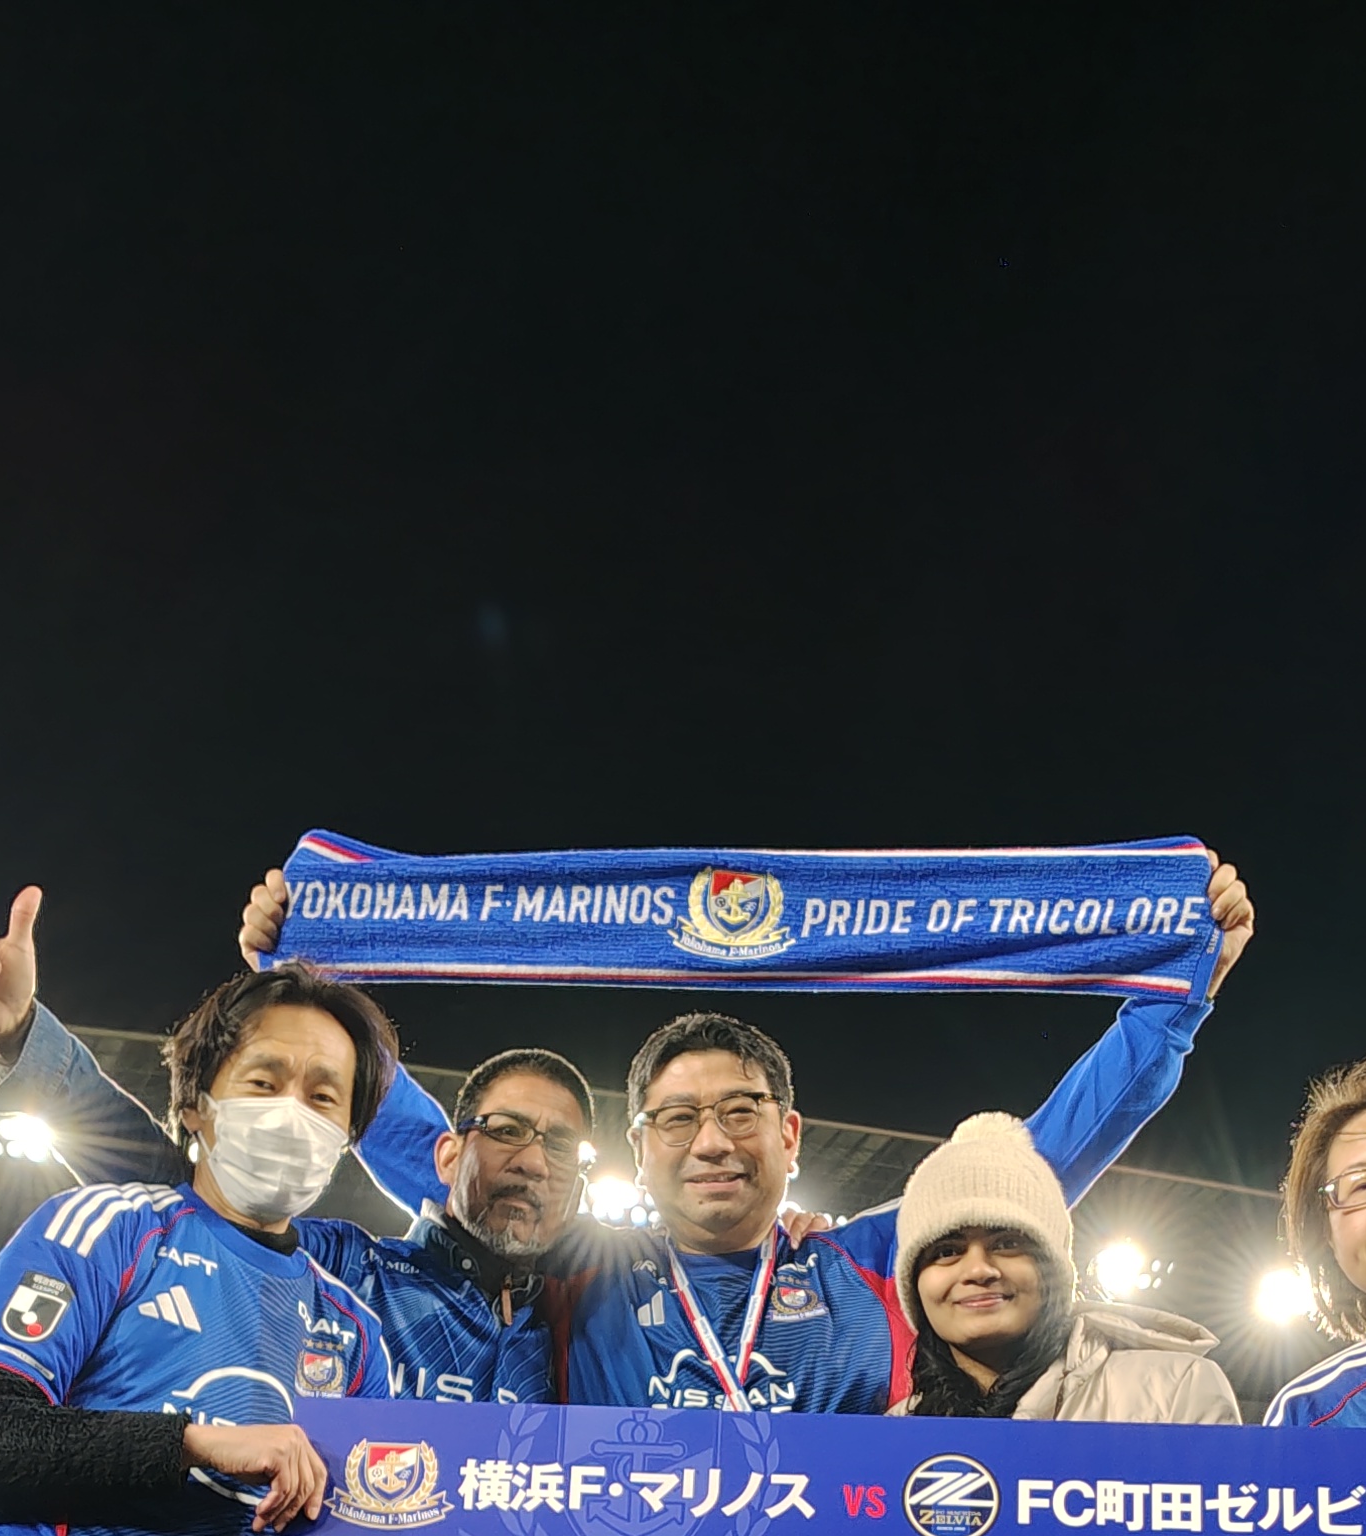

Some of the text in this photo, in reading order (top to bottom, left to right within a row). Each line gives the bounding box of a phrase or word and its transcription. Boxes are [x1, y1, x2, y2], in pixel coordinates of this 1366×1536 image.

[285, 881, 469, 921] YOKOHAMA
[800, 898, 915, 938] PRIDE
[926, 899, 978, 935] OF
[987, 896, 1206, 937] TRICOLORE
[843, 1484, 887, 1519] VS
[919, 1509, 983, 1526] ZELVIA
